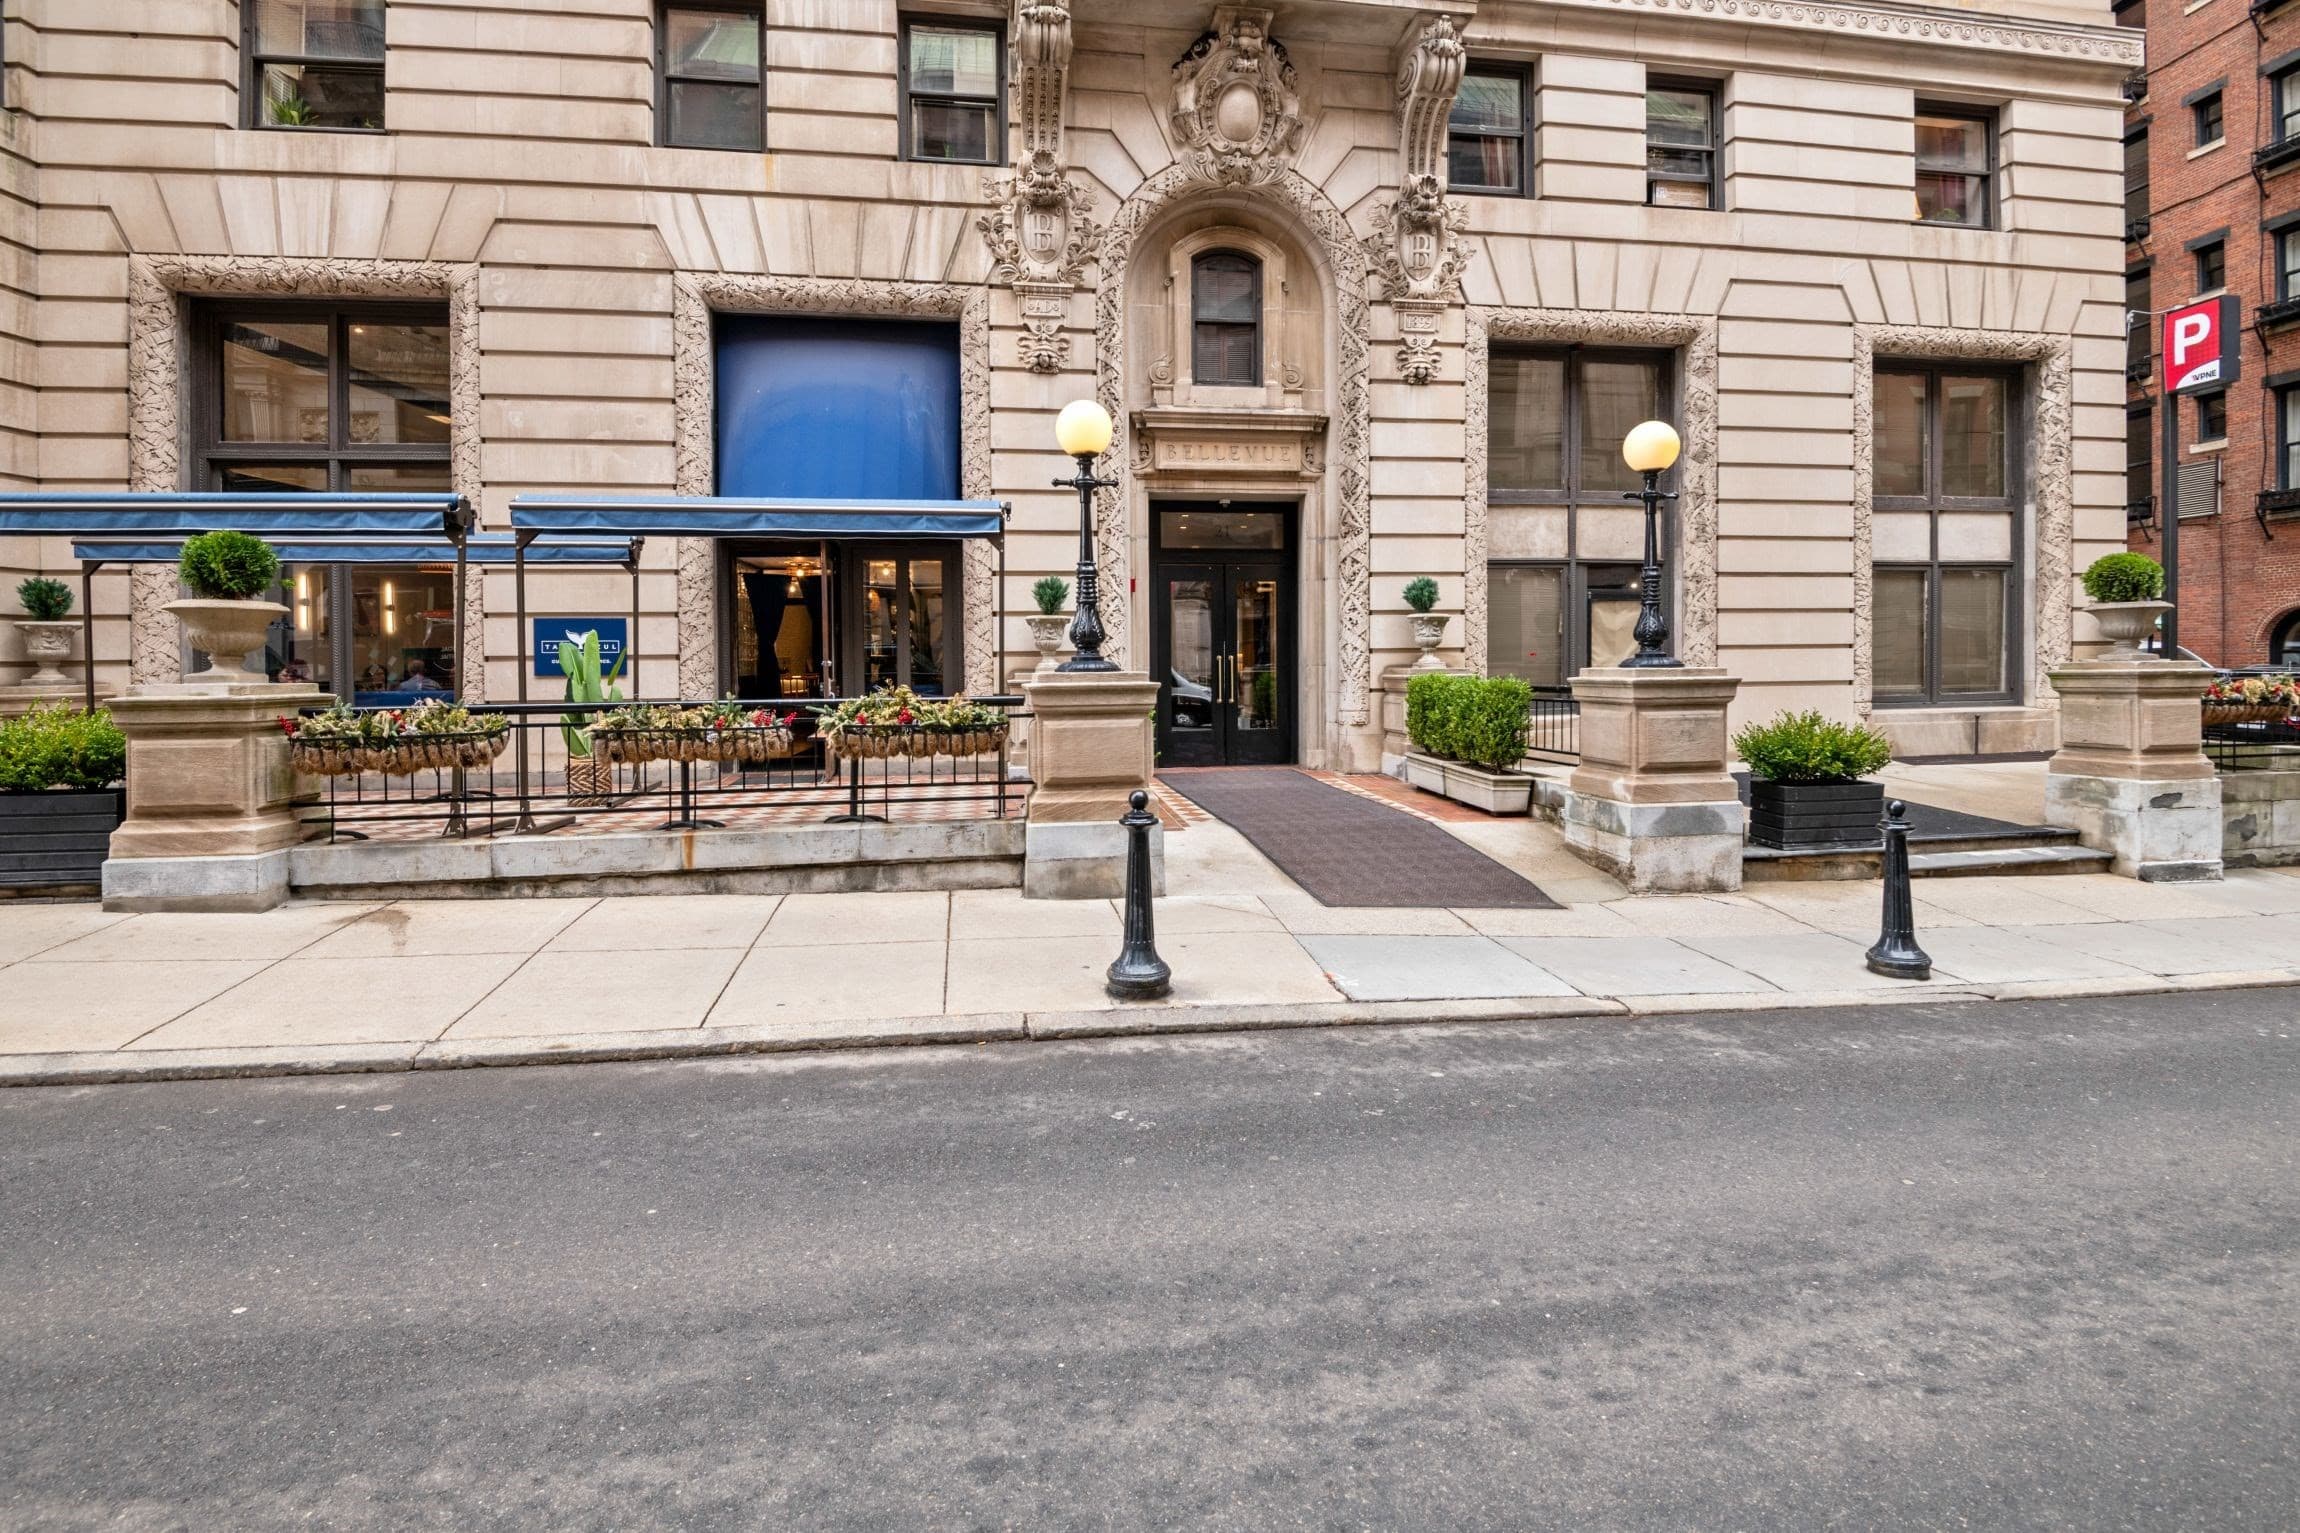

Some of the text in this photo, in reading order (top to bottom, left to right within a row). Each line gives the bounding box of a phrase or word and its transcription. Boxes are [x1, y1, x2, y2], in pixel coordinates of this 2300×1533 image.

[2174, 312, 2212, 367] P
[2193, 369, 2217, 381] VPNE
[1166, 443, 1292, 463] BELLEVUE
